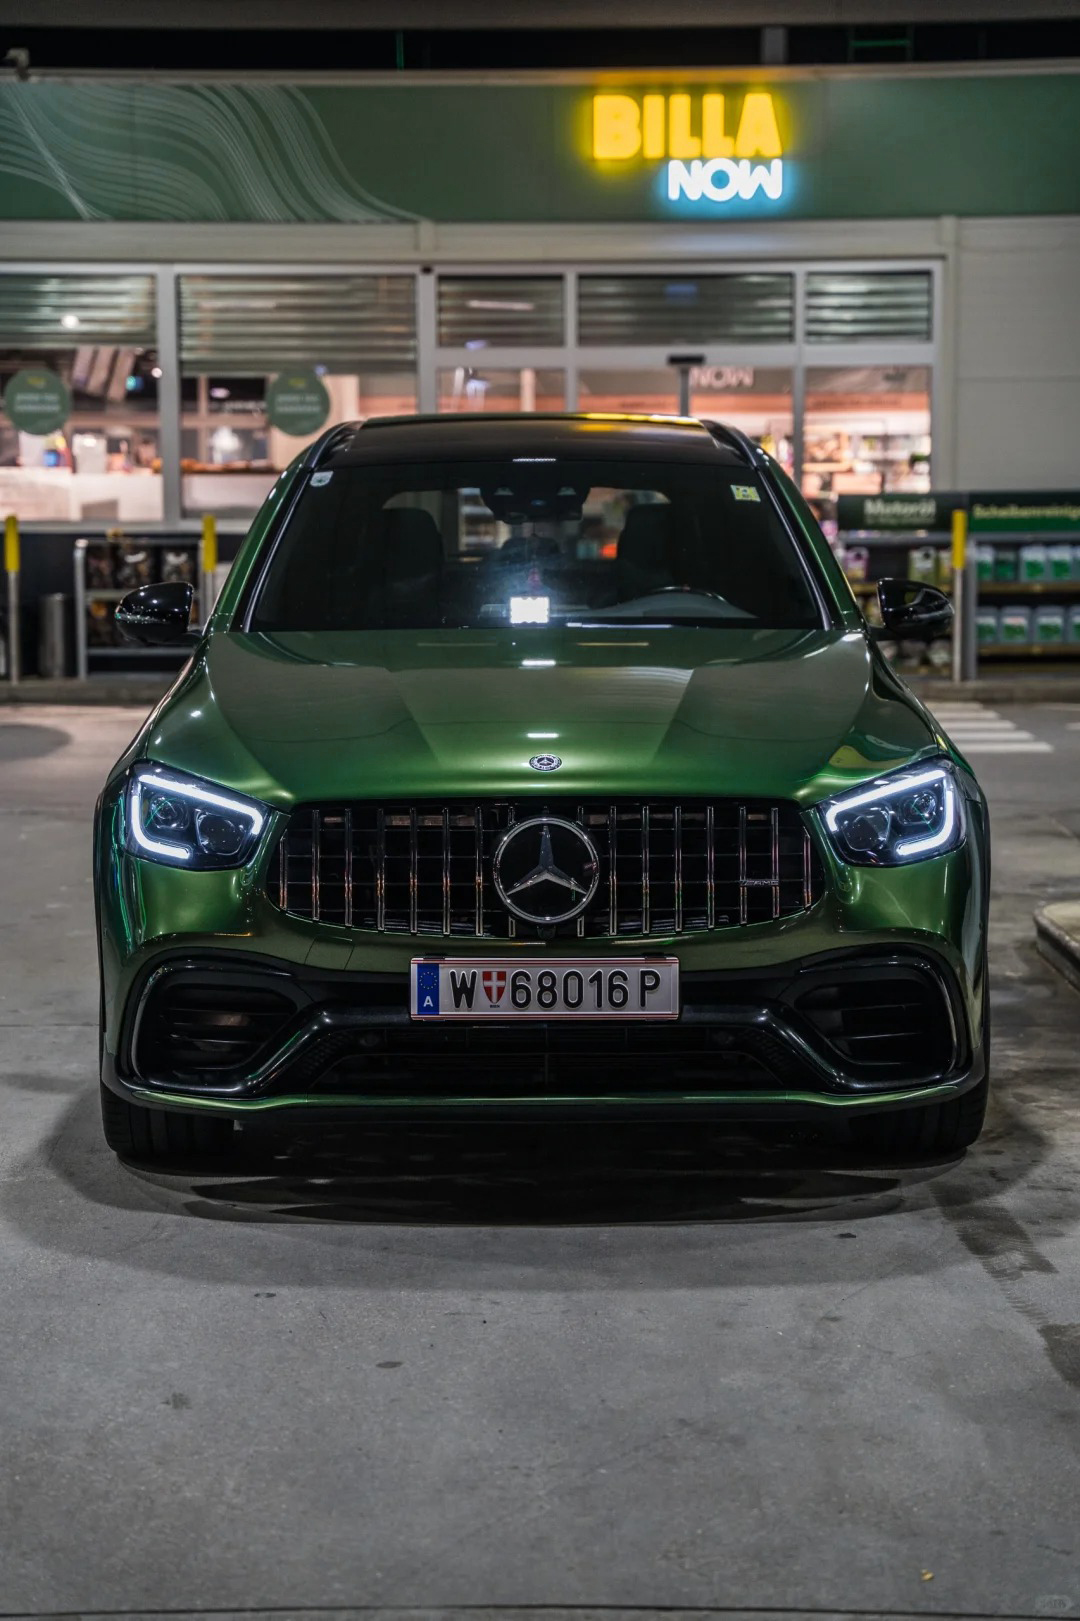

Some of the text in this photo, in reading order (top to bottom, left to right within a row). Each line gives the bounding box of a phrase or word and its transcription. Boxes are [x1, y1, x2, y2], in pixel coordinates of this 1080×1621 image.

[593, 93, 782, 159] BILLA
[668, 158, 783, 202] NOW
[689, 366, 753, 388] NOW
[423, 995, 434, 1008] A
[450, 969, 478, 1009] W
